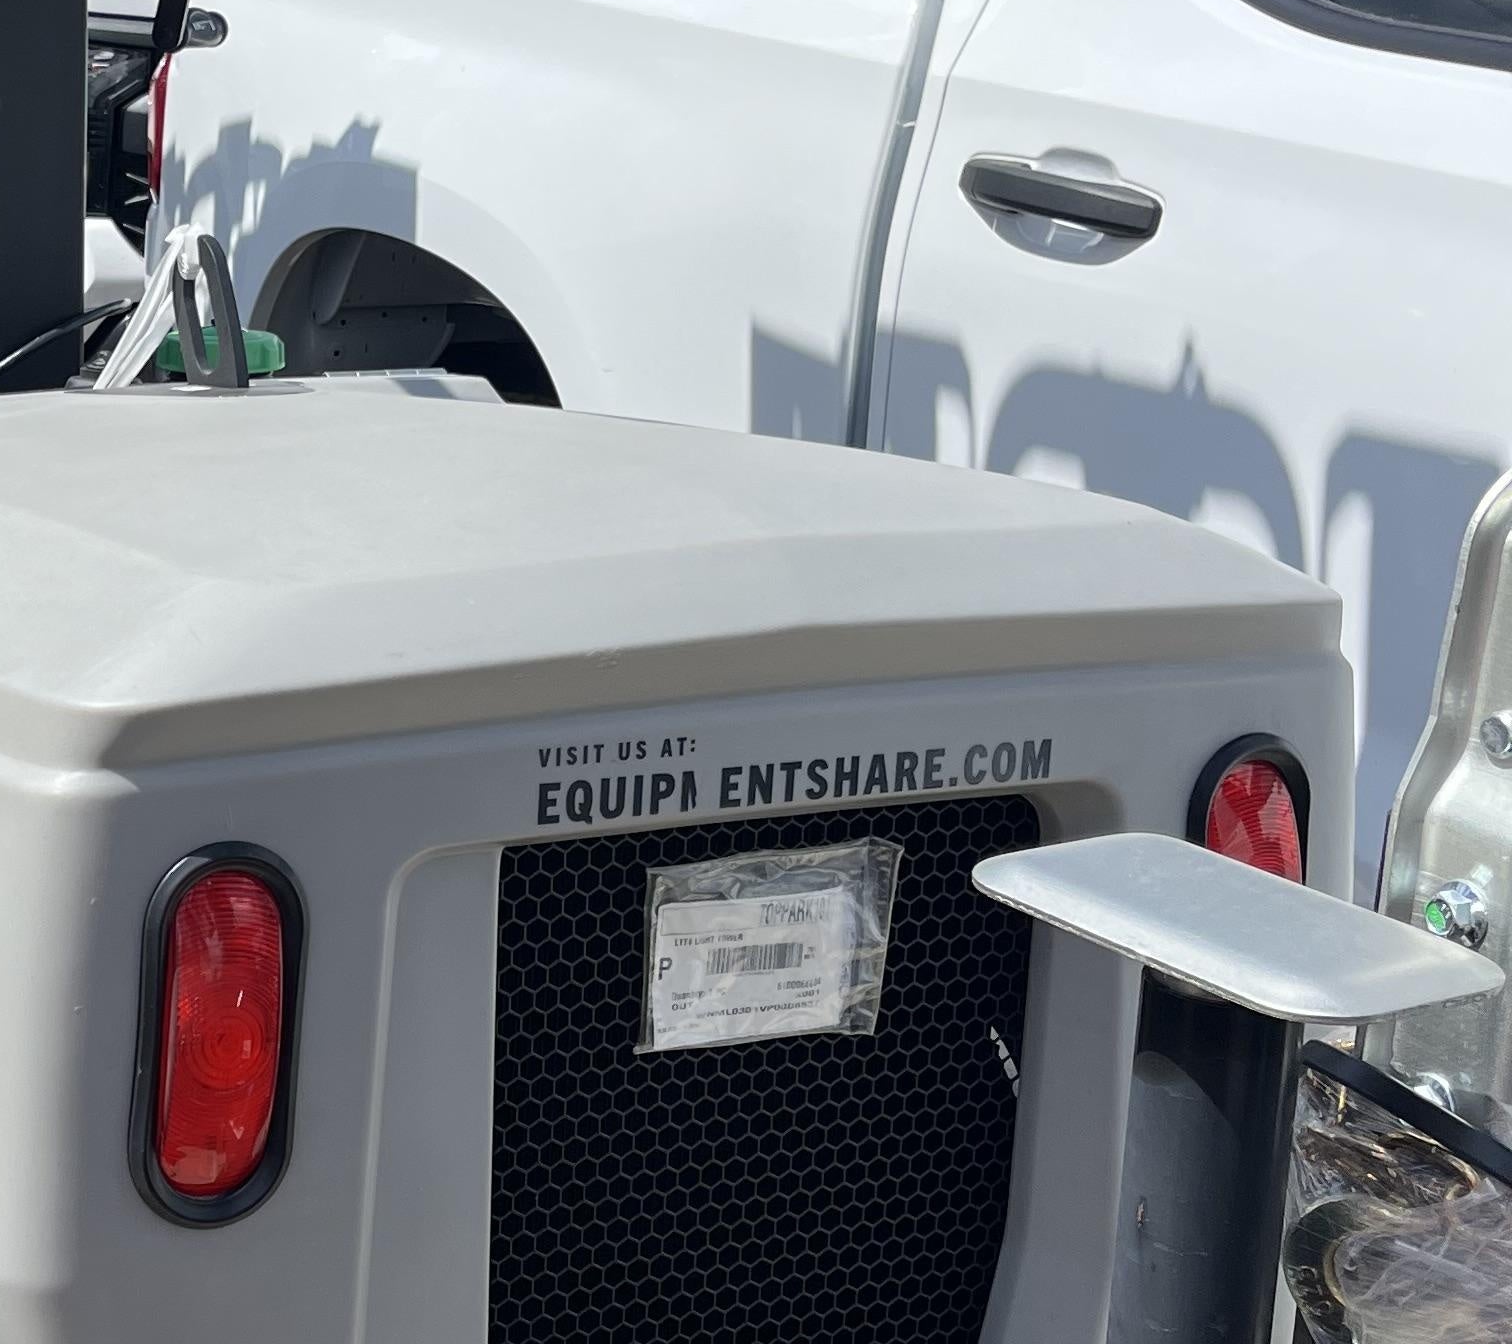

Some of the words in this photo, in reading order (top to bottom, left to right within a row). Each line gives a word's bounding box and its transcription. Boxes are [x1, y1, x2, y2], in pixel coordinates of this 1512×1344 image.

[538, 744, 605, 769] VISIT
[618, 739, 647, 761] US
[660, 736, 696, 758] AT:
[658, 957, 673, 980] P
